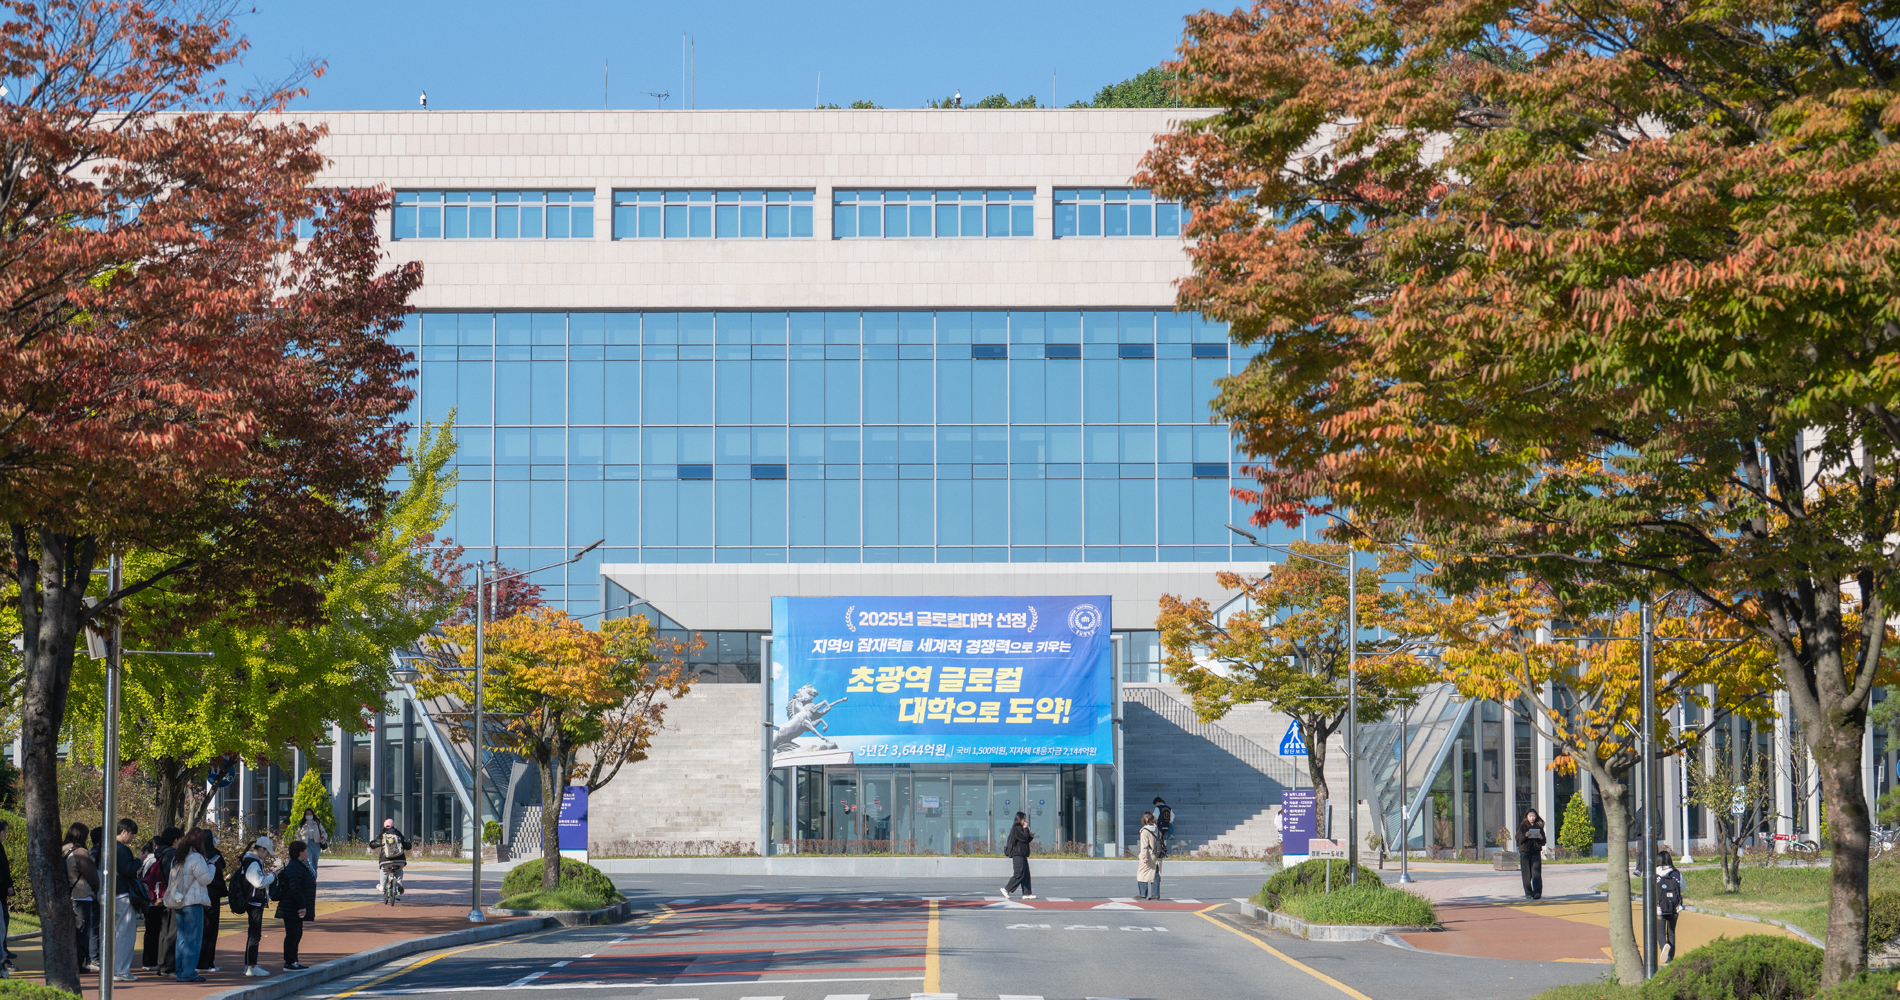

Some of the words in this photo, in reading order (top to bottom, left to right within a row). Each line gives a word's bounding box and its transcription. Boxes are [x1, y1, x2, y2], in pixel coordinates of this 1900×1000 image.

[859, 611, 914, 626] 2025년
[916, 612, 994, 628] 글로컬대학
[996, 612, 1026, 628] 선정
[812, 638, 854, 653] 지역의
[858, 638, 914, 652] 잠재력을
[916, 638, 962, 654] 세계적
[966, 639, 1034, 654] 경쟁력으로
[1036, 640, 1072, 653] 키우는
[846, 666, 933, 694] 초광역
[938, 666, 1024, 693] 글로컬
[898, 697, 1001, 724] 대학으로
[1005, 697, 1072, 724] 도약!
[858, 744, 889, 757] 5년간
[890, 744, 946, 758] 3,644억원
[956, 746, 972, 756] 국비
[972, 746, 1008, 756] 1,500억원,
[1008, 746, 1032, 756] 지자체
[1032, 746, 1062, 756] 대응자금
[1063, 747, 1097, 756] 2,144억원
